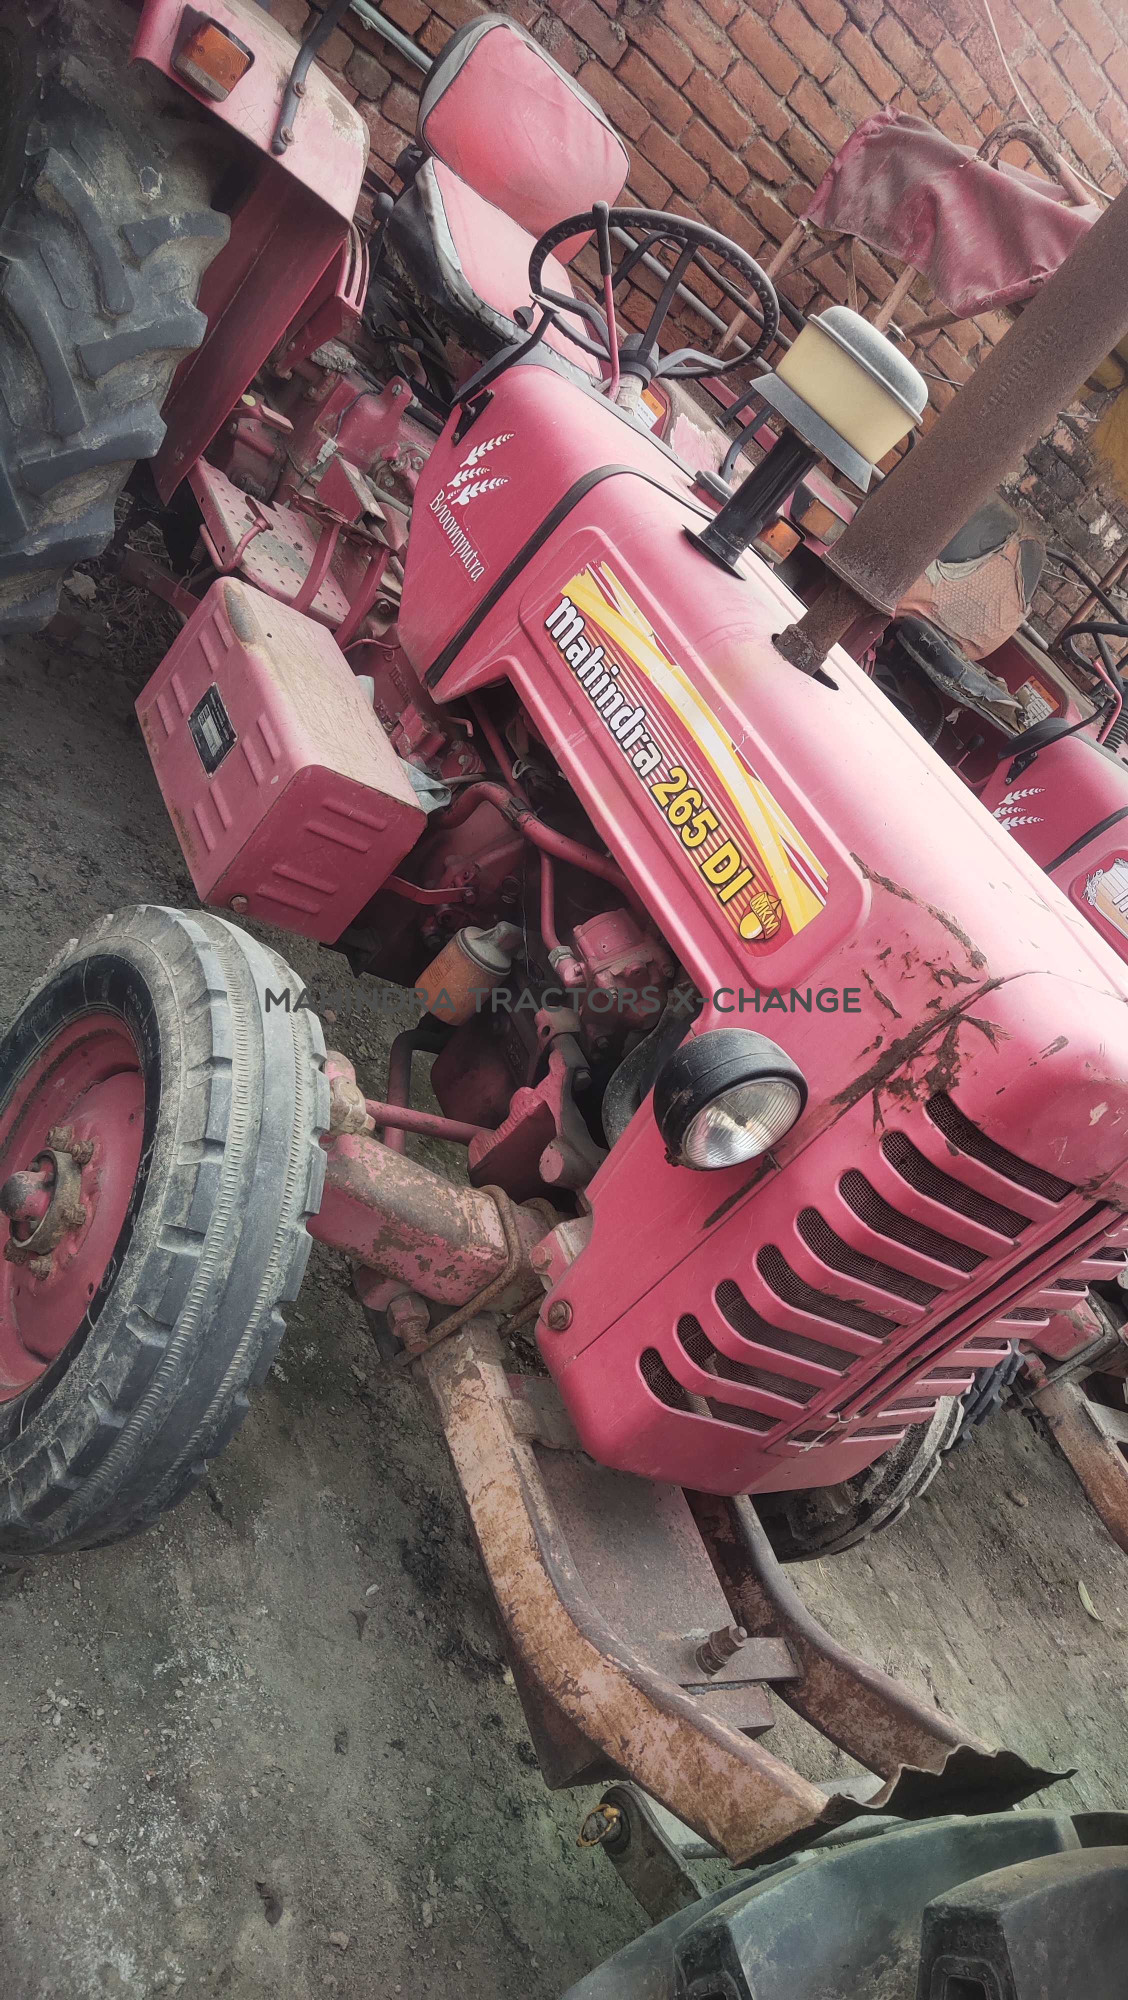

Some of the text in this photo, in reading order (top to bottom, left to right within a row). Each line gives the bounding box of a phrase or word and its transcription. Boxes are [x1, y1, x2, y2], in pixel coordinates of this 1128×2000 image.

[429, 489, 485, 582] Bhoomiputra
[544, 596, 755, 906] Mahindra 265 DI
[753, 893, 779, 935] MKM
